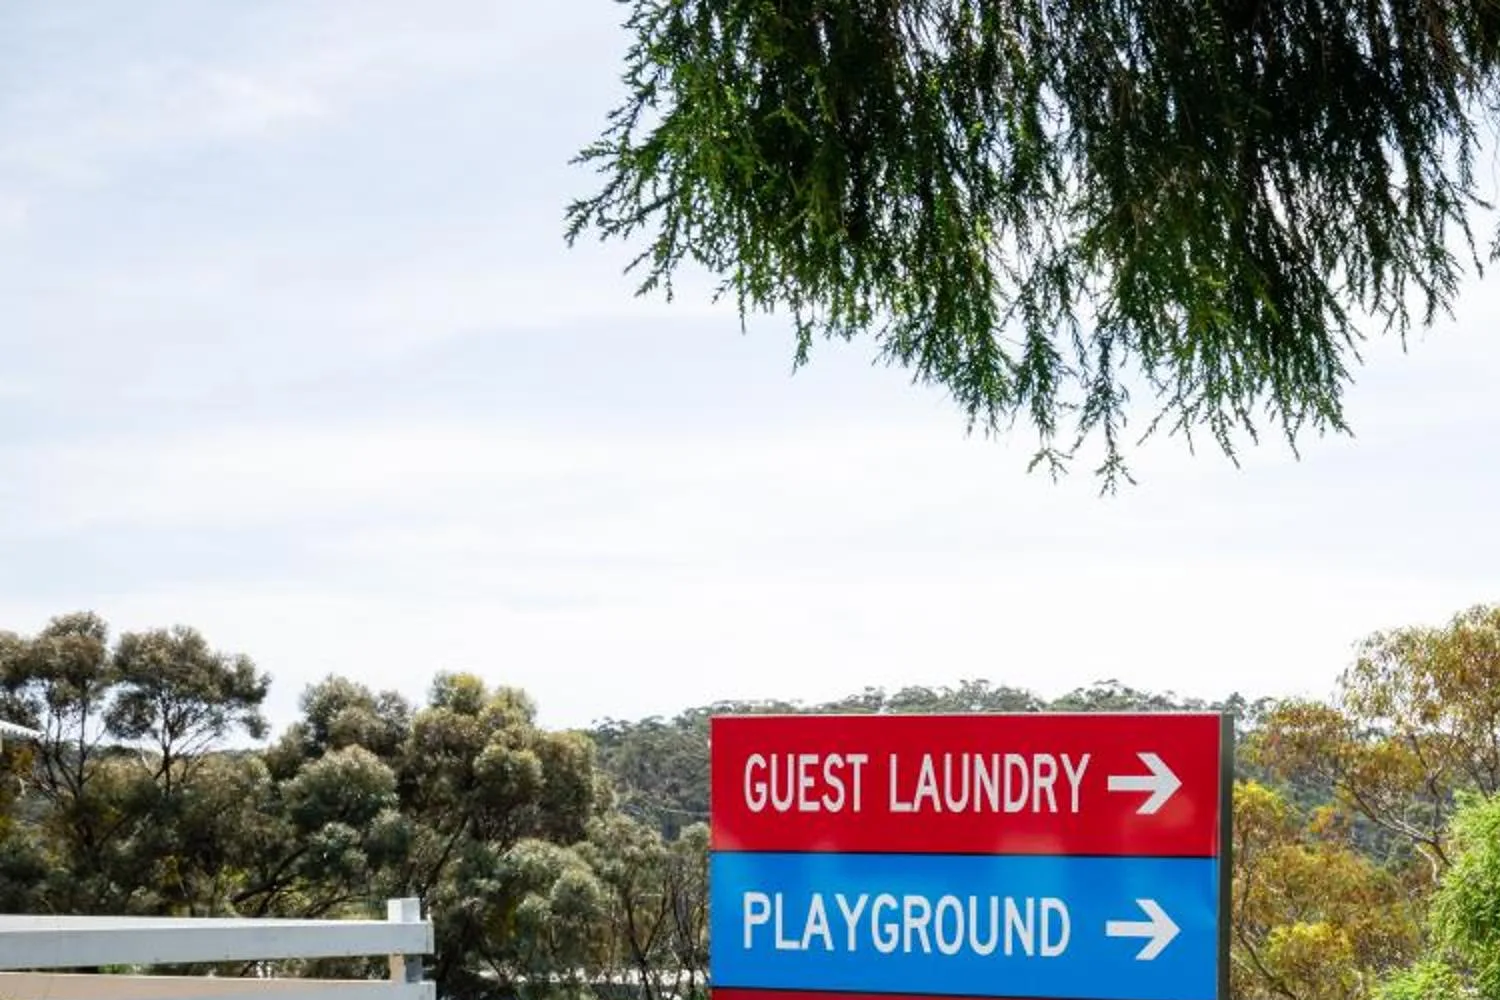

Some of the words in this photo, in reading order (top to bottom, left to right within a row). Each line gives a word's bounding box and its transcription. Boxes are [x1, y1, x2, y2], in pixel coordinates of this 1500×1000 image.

[744, 753, 868, 813] GUEST
[889, 753, 1091, 813] LAUNDRY
[743, 892, 1071, 957] PLAYGROUND
